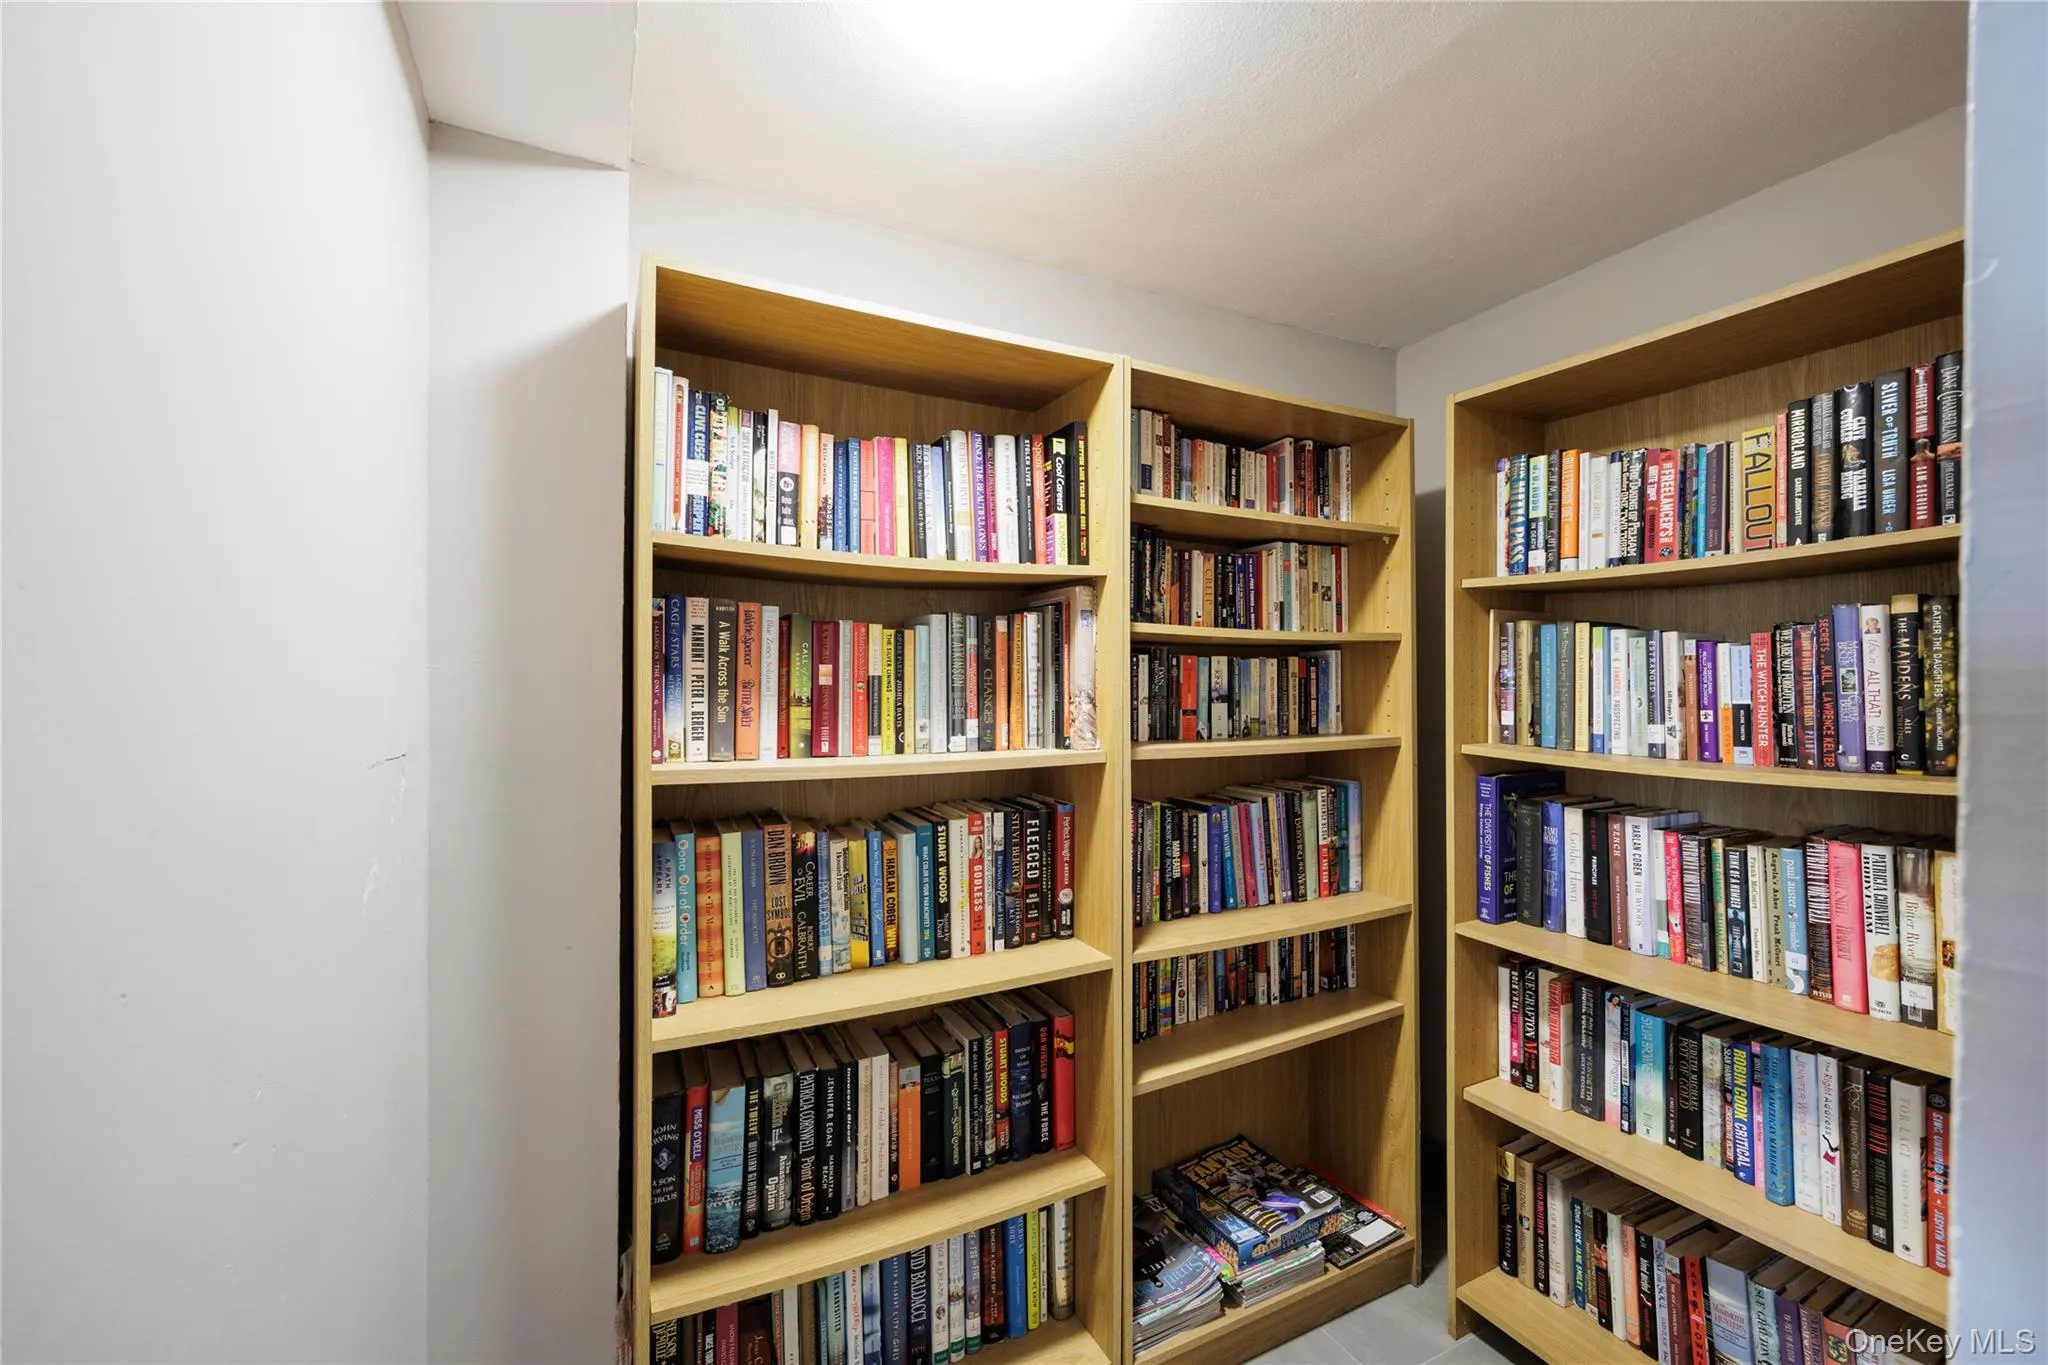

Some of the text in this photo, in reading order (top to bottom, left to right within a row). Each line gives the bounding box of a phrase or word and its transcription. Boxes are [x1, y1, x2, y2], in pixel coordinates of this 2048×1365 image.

[695, 406, 706, 431] CLIVE
[1840, 409, 1852, 444] CUSSLER
[1881, 382, 1898, 459] SLIVER OF TRUTH
[1937, 366, 1963, 443] DIANE CHAMBERLAIN
[1790, 409, 1804, 470] MIRRORLAND
[1855, 416, 1866, 441] CLIVE
[1056, 457, 1064, 511] Cool Careers
[1659, 469, 1674, 537] FREELANCER'S
[1744, 433, 1772, 553] FALLOUT
[1841, 472, 1853, 499] RISING
[1853, 468, 1867, 512] VALHALLA
[1882, 469, 1897, 514] LISA UNGER
[671, 599, 680, 627] CAGE
[1819, 618, 1829, 652] SECRETS
[671, 637, 680, 668] STARS
[691, 624, 704, 663] MANHUNT
[719, 631, 730, 653] Walk
[1896, 617, 1911, 700] THE MAIDENS
[1932, 605, 1943, 698] GATHER THE DAUGHTERS
[691, 674, 704, 699] PETER
[718, 656, 729, 686] Across
[1648, 640, 1656, 692] ESTRANGED
[718, 689, 729, 703] the
[718, 706, 727, 723] Sun
[983, 669, 993, 724] CHANGES
[1613, 667, 1621, 740] FANATICAL PROSPECTING
[1757, 648, 1768, 746] THE WITCH HUNTER
[691, 711, 705, 742] BERGEN
[1822, 692, 1835, 768] LAWRENCE KELTER
[1876, 726, 1884, 746] PAULA
[678, 840, 689, 871] Oona
[768, 830, 786, 886] DAN BROWN
[938, 825, 948, 904] STUART WOODS
[1012, 813, 1021, 879] STEVE BERRY
[1027, 819, 1039, 879] FLEECED
[1165, 845, 1171, 856] OF
[1484, 803, 1492, 891] THE DIVERSITY OF FISHES
[1631, 824, 1642, 876] HARLAN COBEN
[679, 875, 689, 897] Out
[679, 900, 690, 909] of
[794, 877, 805, 906] EVIL
[886, 858, 896, 948] HARLAN COBEN WIN
[974, 865, 982, 912] GODLESS
[1783, 859, 1799, 951] paul auster invisible
[1806, 843, 1830, 924] PATRICIA CORNWELL
[1871, 854, 1890, 936] PATRICIA CORNWELL
[679, 913, 690, 946] Order
[797, 912, 806, 969] GALBRAITH
[1905, 901, 1919, 960] Bitter River
[999, 1038, 1007, 1069] STUART
[1679, 1037, 1690, 1109] POT OF GOLD
[1689, 1039, 1698, 1112] JUDITH MICHAEL
[749, 1089, 758, 1136] THE TWELVE
[799, 1074, 814, 1154] PATRICIA CORNWELL
[1041, 1117, 1049, 1142] FORCE
[1733, 1048, 1750, 1167] ROBIN COOK CRITICAL
[694, 1109, 703, 1159] MISS O'DELL
[825, 1122, 833, 1147] EGAN
[766, 1176, 778, 1211] Option
[779, 1155, 787, 1211] Assassination
[799, 1156, 813, 1221] Point of Origin
[821, 1166, 829, 1190] BEACH
[1536, 1173, 1544, 1199] BLOOD
[1574, 1205, 1582, 1224] SOME
[910, 1272, 927, 1323] BALDACCI
[1032, 1284, 1038, 1292] WE
[1576, 1266, 1584, 1290] SMILEY
[1785, 1334, 1794, 1342] IN
[1786, 1343, 1795, 1362] BLOOM
